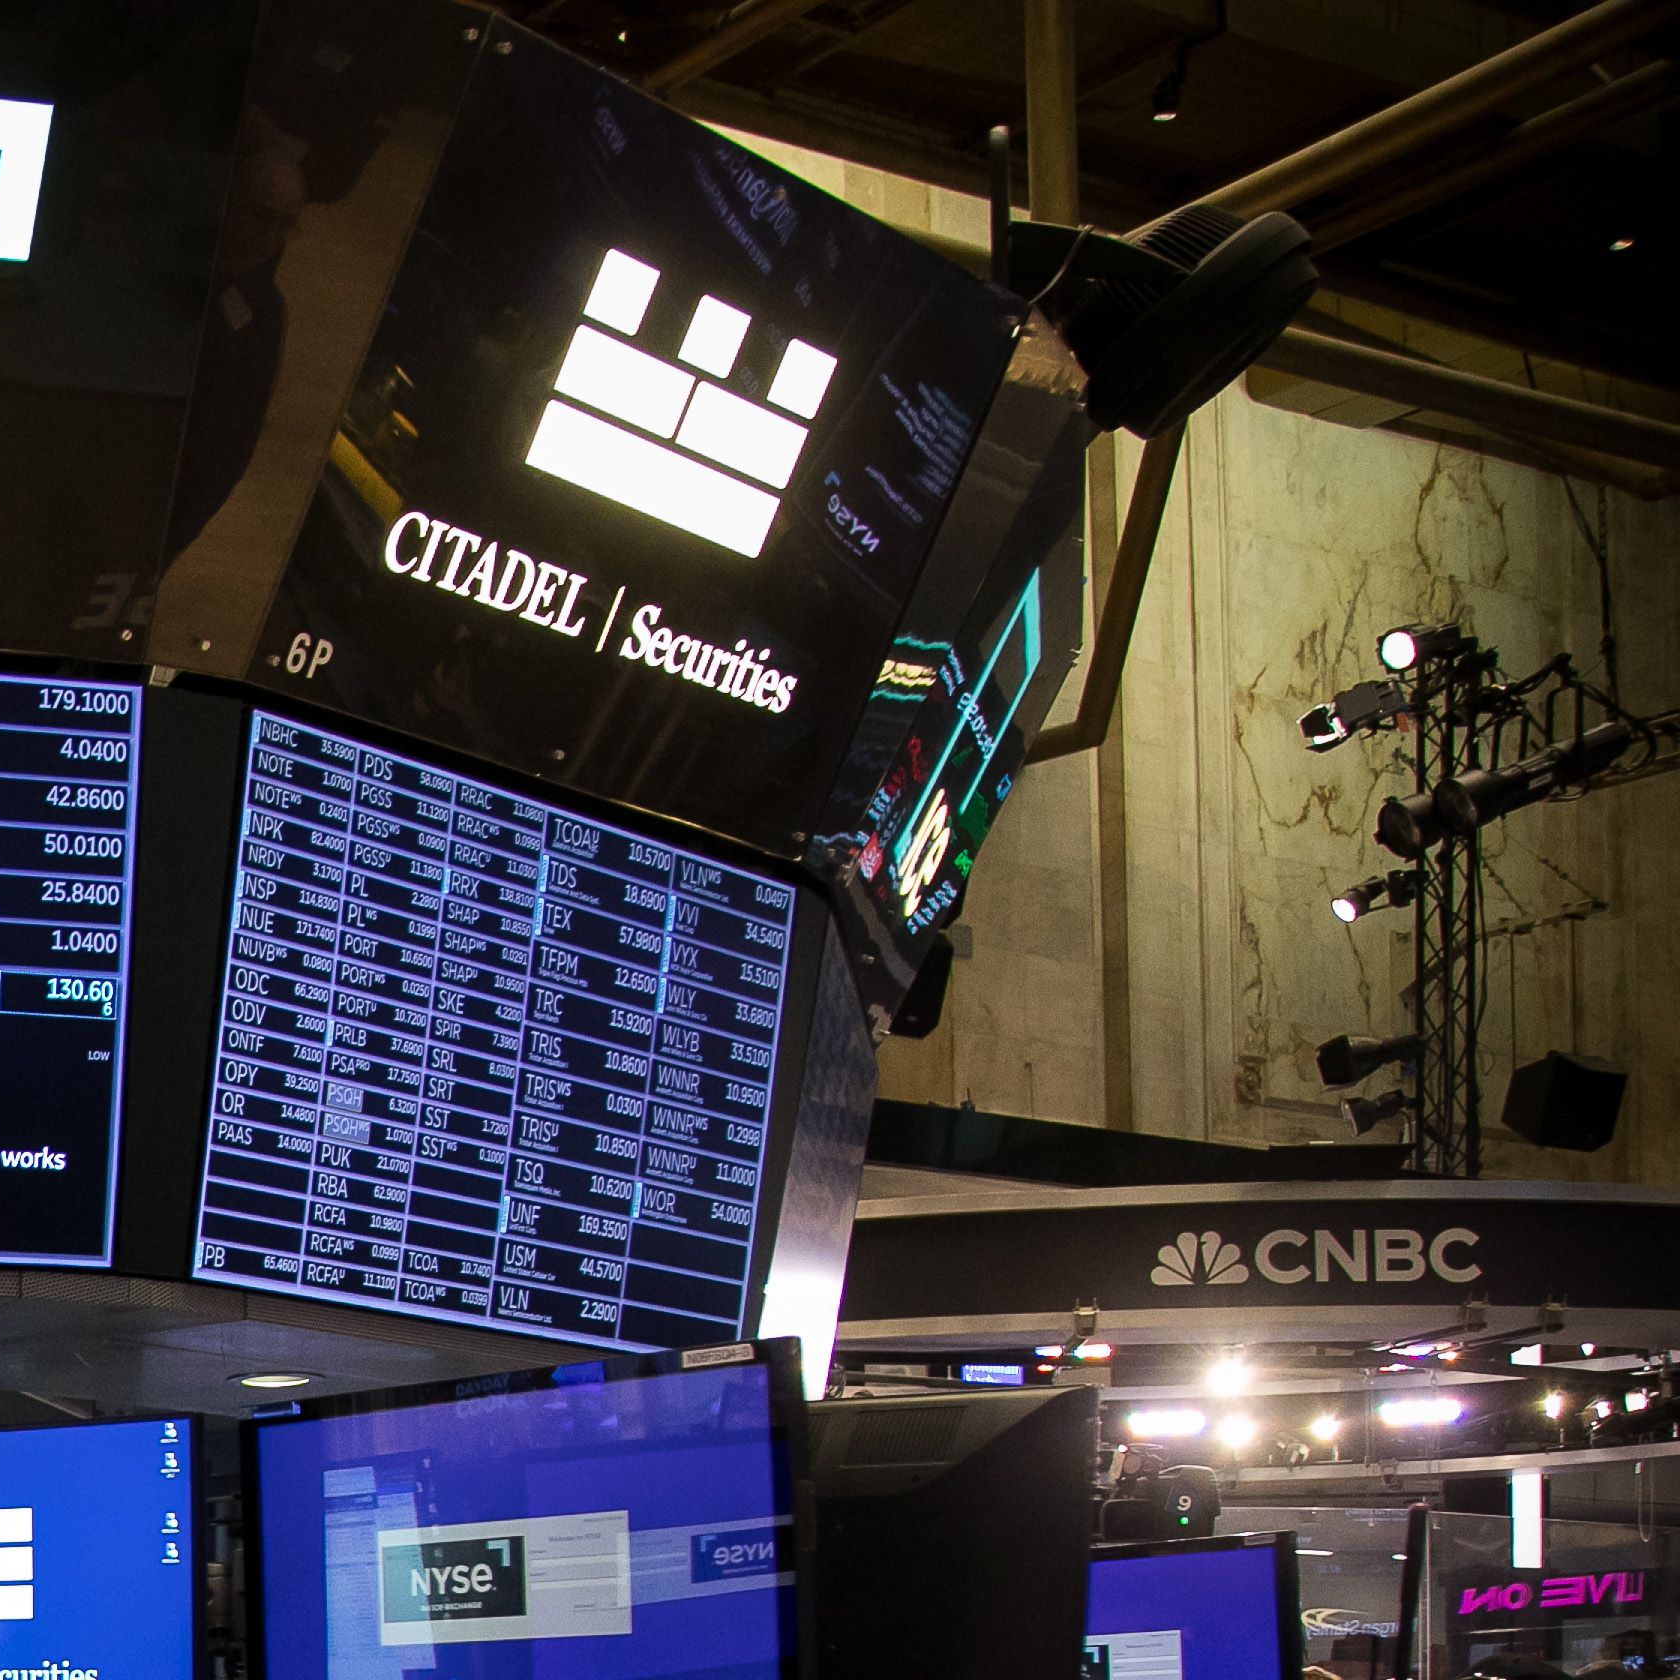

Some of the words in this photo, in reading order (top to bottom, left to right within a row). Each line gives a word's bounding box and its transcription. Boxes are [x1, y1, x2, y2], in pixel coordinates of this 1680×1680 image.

[385, 512, 585, 652] CITADEL
[622, 598, 797, 713] Securities
[286, 632, 334, 679] 6P
[39, 688, 130, 715] 179.1000
[47, 977, 114, 1002] 130.60
[0, 1146, 66, 1170] works
[510, 1200, 541, 1226] UNF
[578, 1214, 628, 1241] 169.3500
[1254, 1227, 1483, 1285] CNBC
[1176, 1493, 1193, 1514] 9
